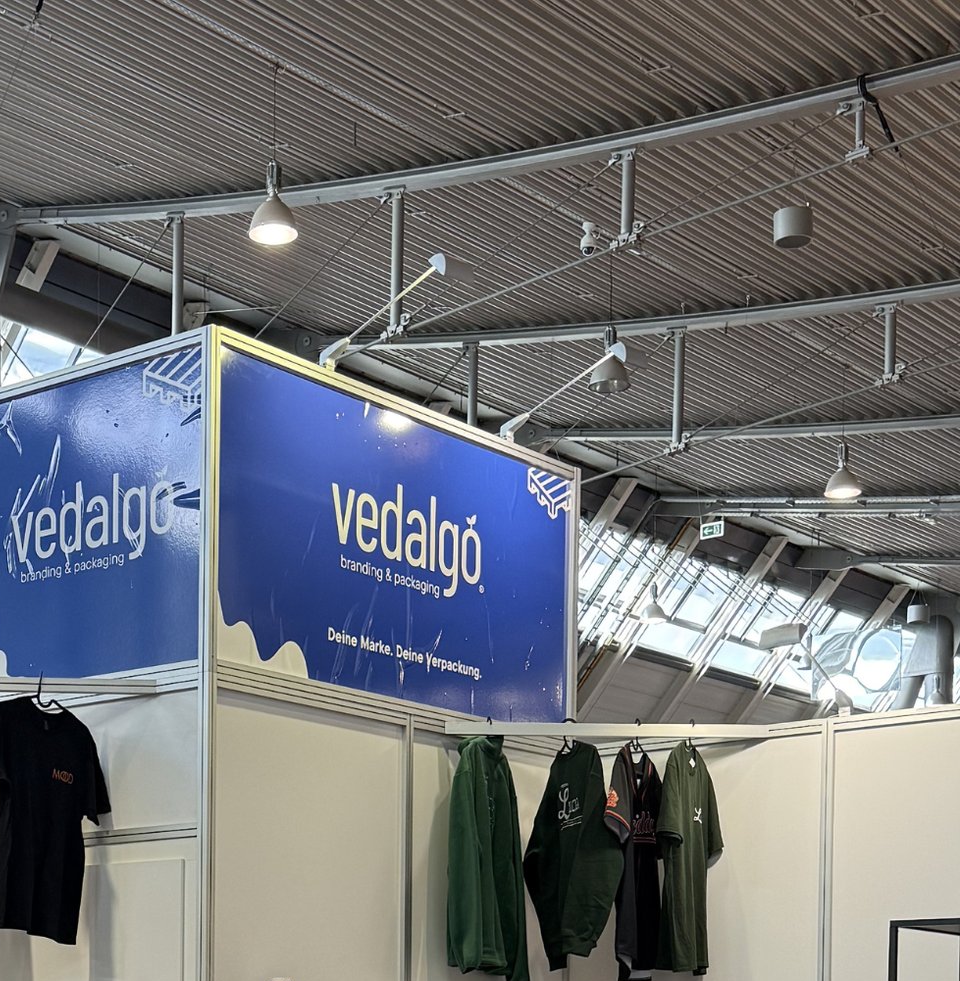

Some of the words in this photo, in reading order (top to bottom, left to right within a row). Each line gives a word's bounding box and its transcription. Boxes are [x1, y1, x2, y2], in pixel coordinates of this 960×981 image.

[20, 565, 63, 583] branding
[64, 563, 72, 574] &
[74, 553, 125, 574] packaging
[340, 554, 383, 582] branding
[385, 568, 392, 582] &
[394, 573, 440, 599] packaging
[327, 627, 357, 647] Deine
[360, 635, 393, 656] Marke.
[396, 644, 424, 664] Deine
[426, 652, 482, 681] Verpackung.
